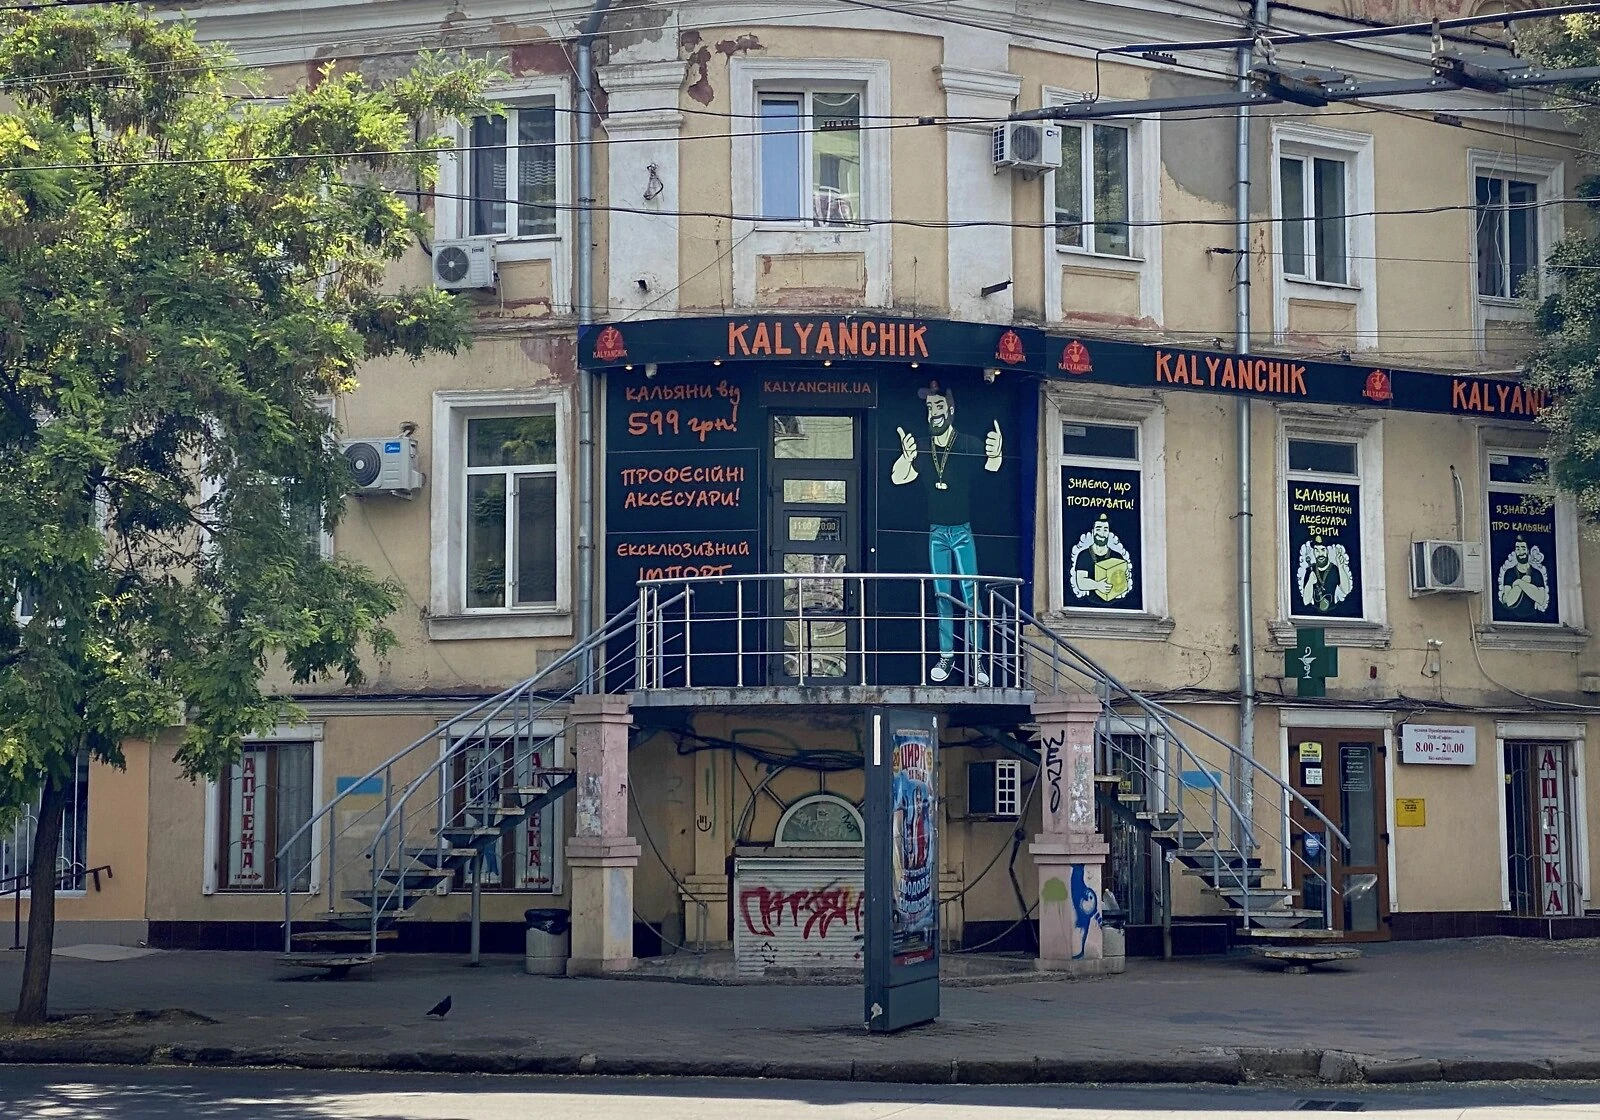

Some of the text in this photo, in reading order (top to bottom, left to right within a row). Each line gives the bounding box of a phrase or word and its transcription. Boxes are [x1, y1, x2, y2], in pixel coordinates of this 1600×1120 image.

[728, 321, 929, 358] KALYANCHIK
[1156, 350, 1307, 395] KALYANCHIK
[625, 384, 713, 402] КАЛЬЯНИ
[763, 380, 872, 394] KALYANCHIK.UA
[628, 404, 738, 442] 599 грн!
[620, 465, 745, 486] ПРОФЕСІЙНІ
[1068, 477, 1112, 494] ЗНАЄМО,
[623, 487, 741, 509] АКСЕСУАРИ!
[1066, 495, 1134, 511] ПОДАРУВАТИ!
[1295, 487, 1351, 505] КАЛЬЯНИ
[1293, 503, 1353, 515] КОМПЛЕКТУЮЧІ
[1299, 514, 1348, 527] АКСЕСУАРИ
[1491, 521, 1552, 534] ПРО КАЛЬЯНИ!
[1307, 525, 1340, 538] БОНГИ
[616, 541, 750, 559] ЕКСКЛЮЗИВНИЙ
[1415, 741, 1434, 753] 8.00
[1441, 742, 1465, 754] 20.00
[242, 757, 256, 869] АПТЕКА
[1540, 749, 1563, 912] АПТЕКА
